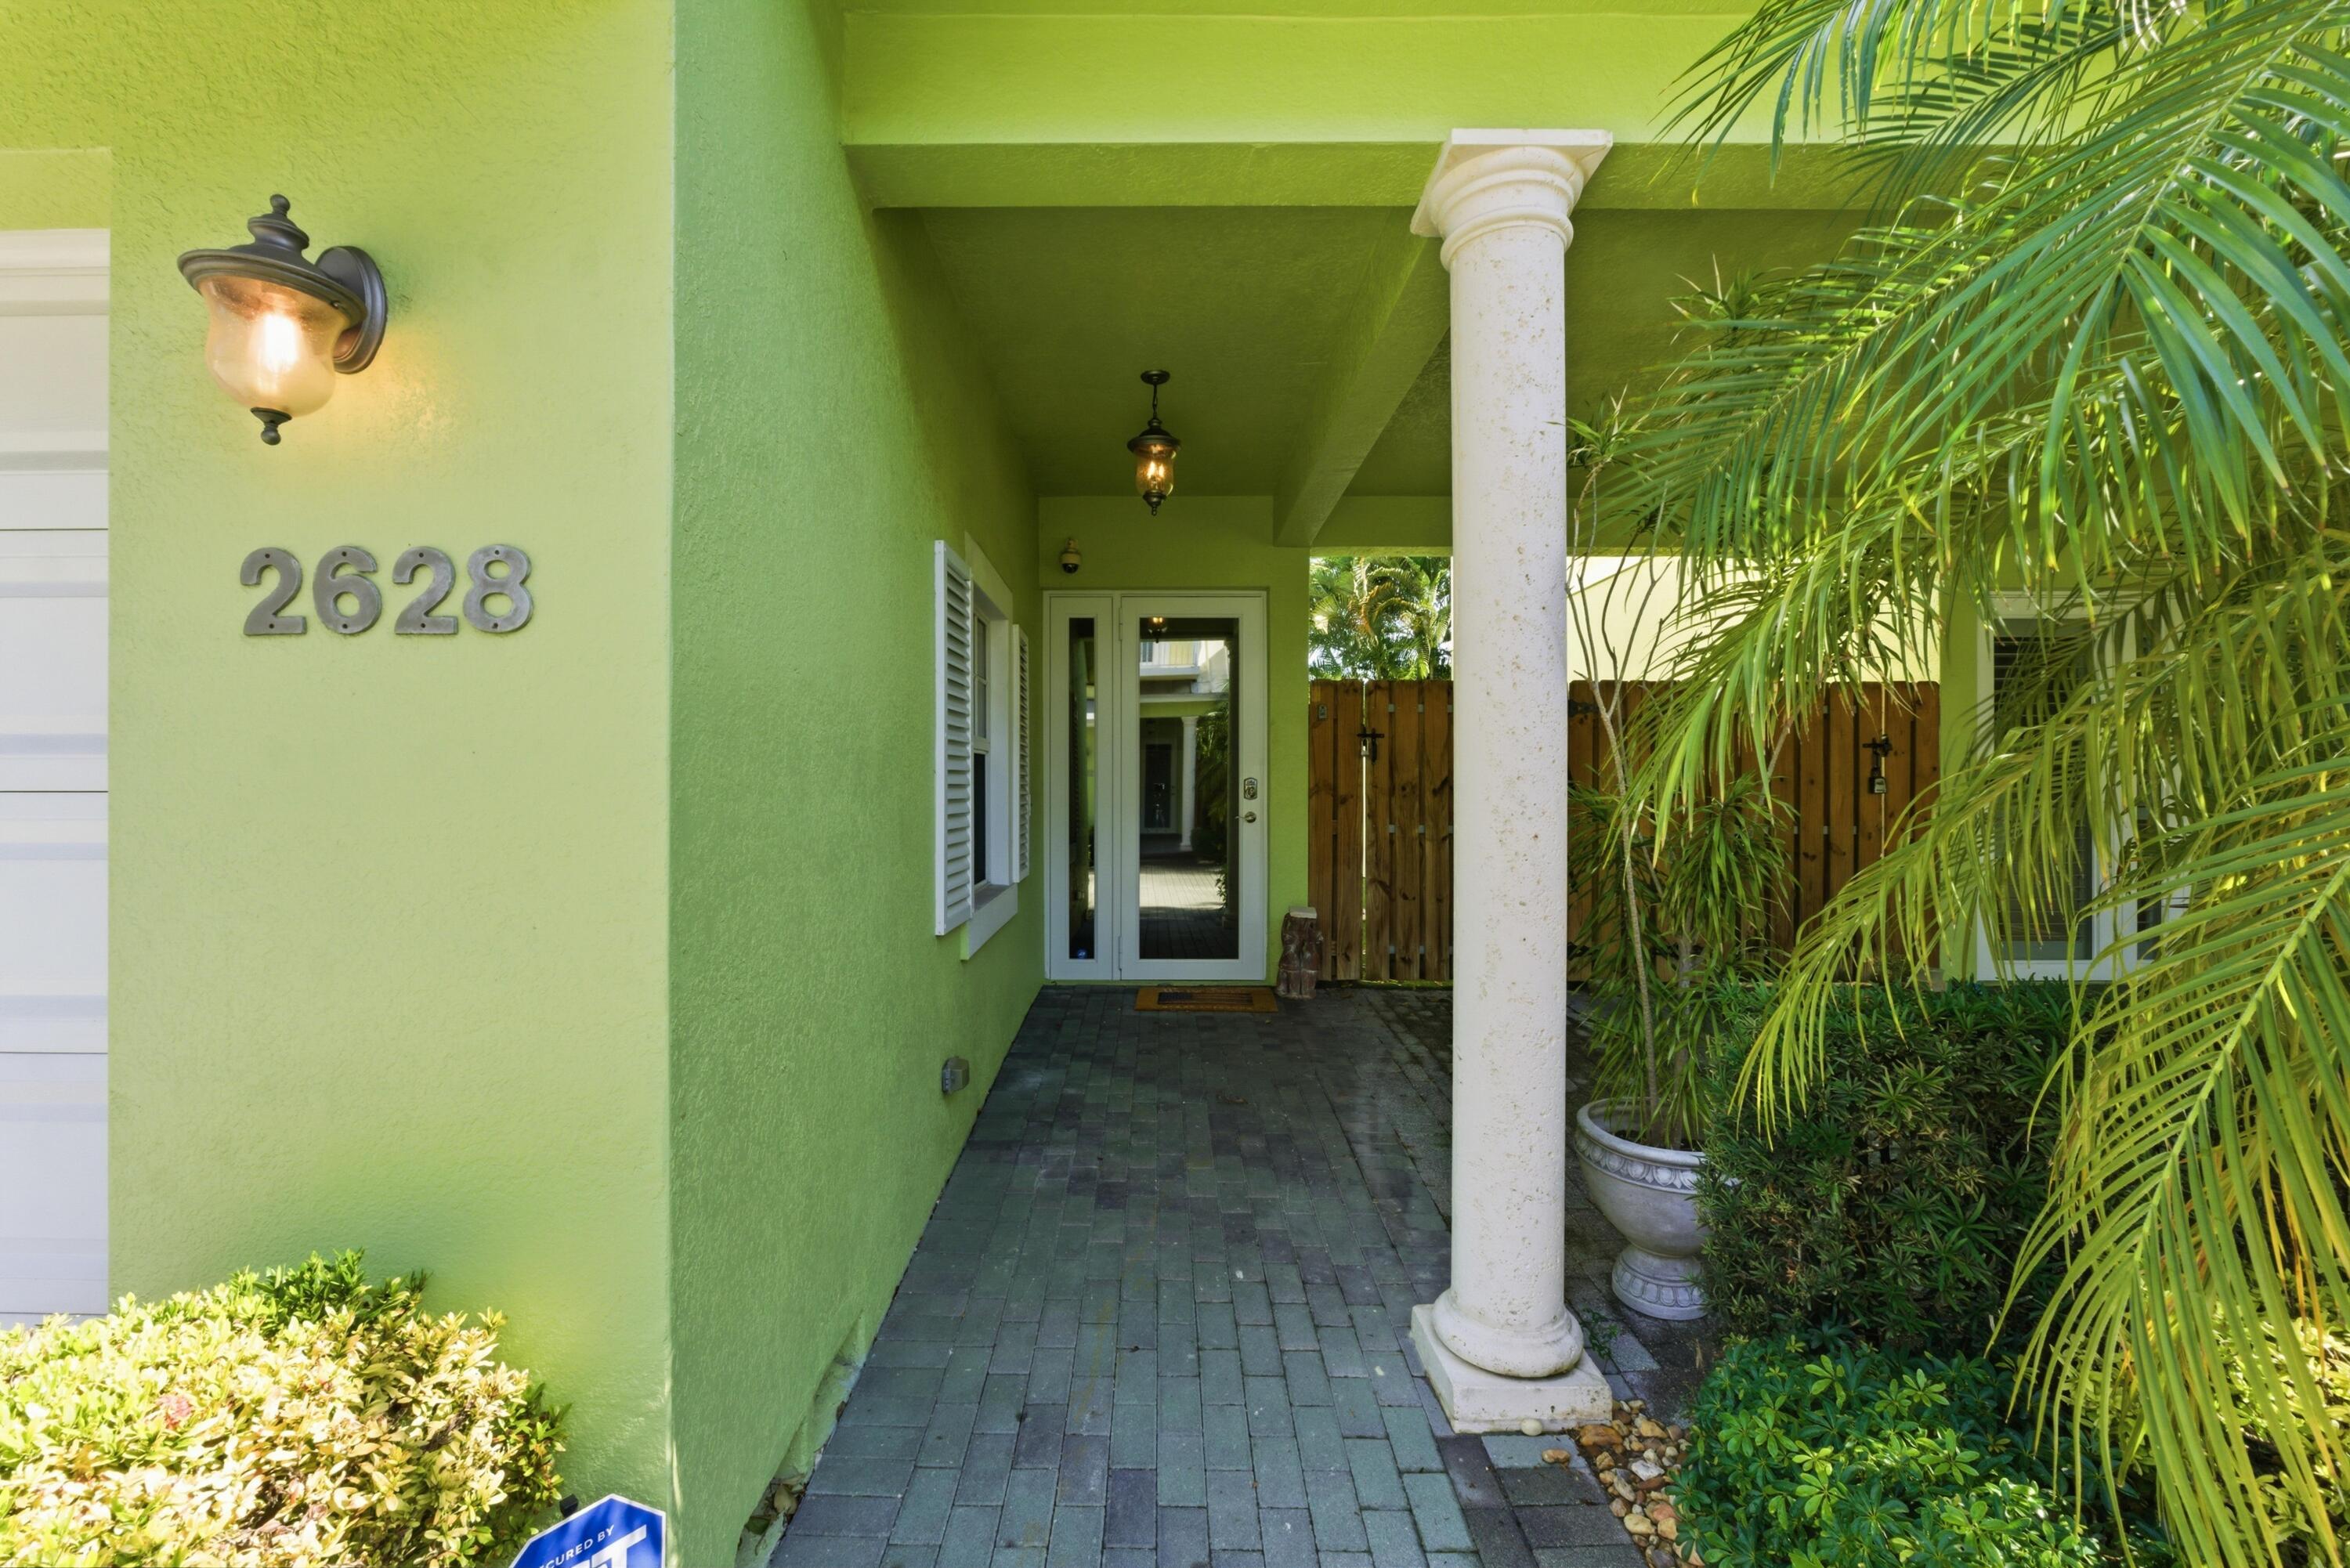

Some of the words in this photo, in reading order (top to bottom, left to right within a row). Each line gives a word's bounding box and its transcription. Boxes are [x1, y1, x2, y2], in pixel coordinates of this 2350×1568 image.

[240, 544, 533, 635] 2628
[540, 1538, 594, 1568] CURED
[598, 1524, 614, 1542] BY
